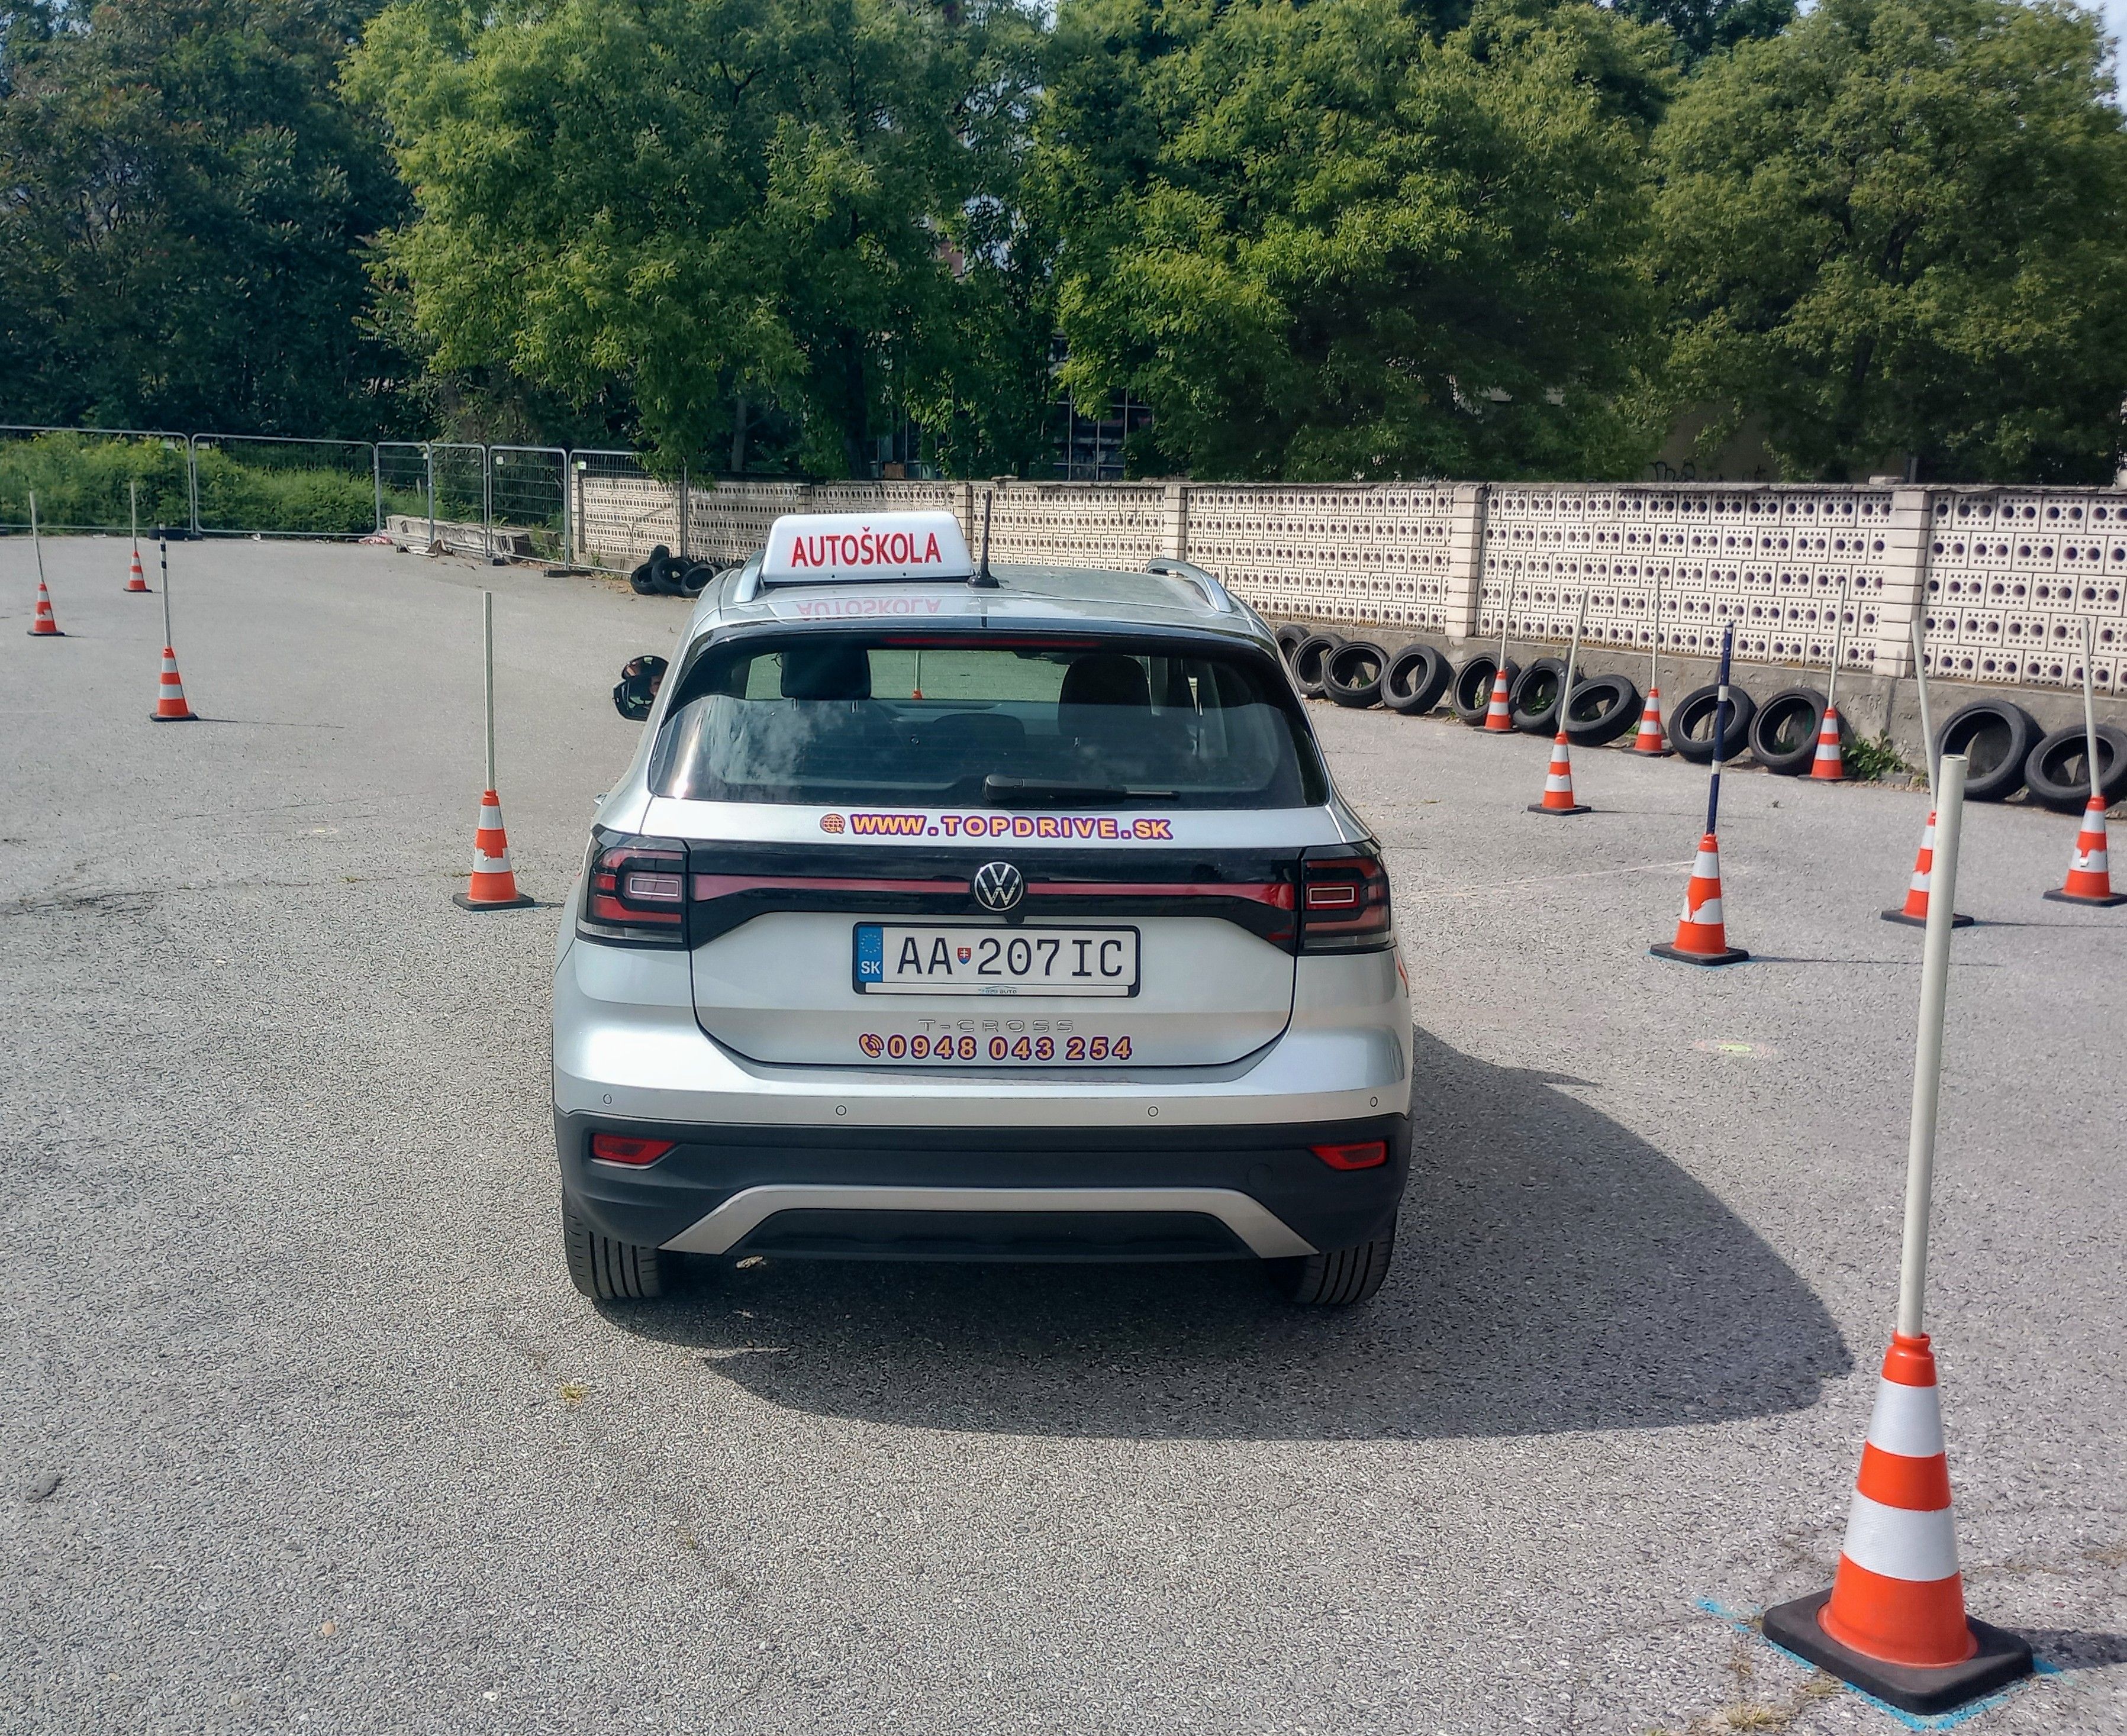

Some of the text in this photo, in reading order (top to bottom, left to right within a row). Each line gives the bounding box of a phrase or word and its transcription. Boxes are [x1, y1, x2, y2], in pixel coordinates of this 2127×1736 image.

[791, 527, 942, 567] AUTOŠKOLA
[850, 814, 1174, 840] WWW.TOPDRIVE.SK
[861, 961, 880, 975] SK
[918, 1019, 1074, 1032] T-CROSS
[887, 1034, 1132, 1061] 0948 043 254
